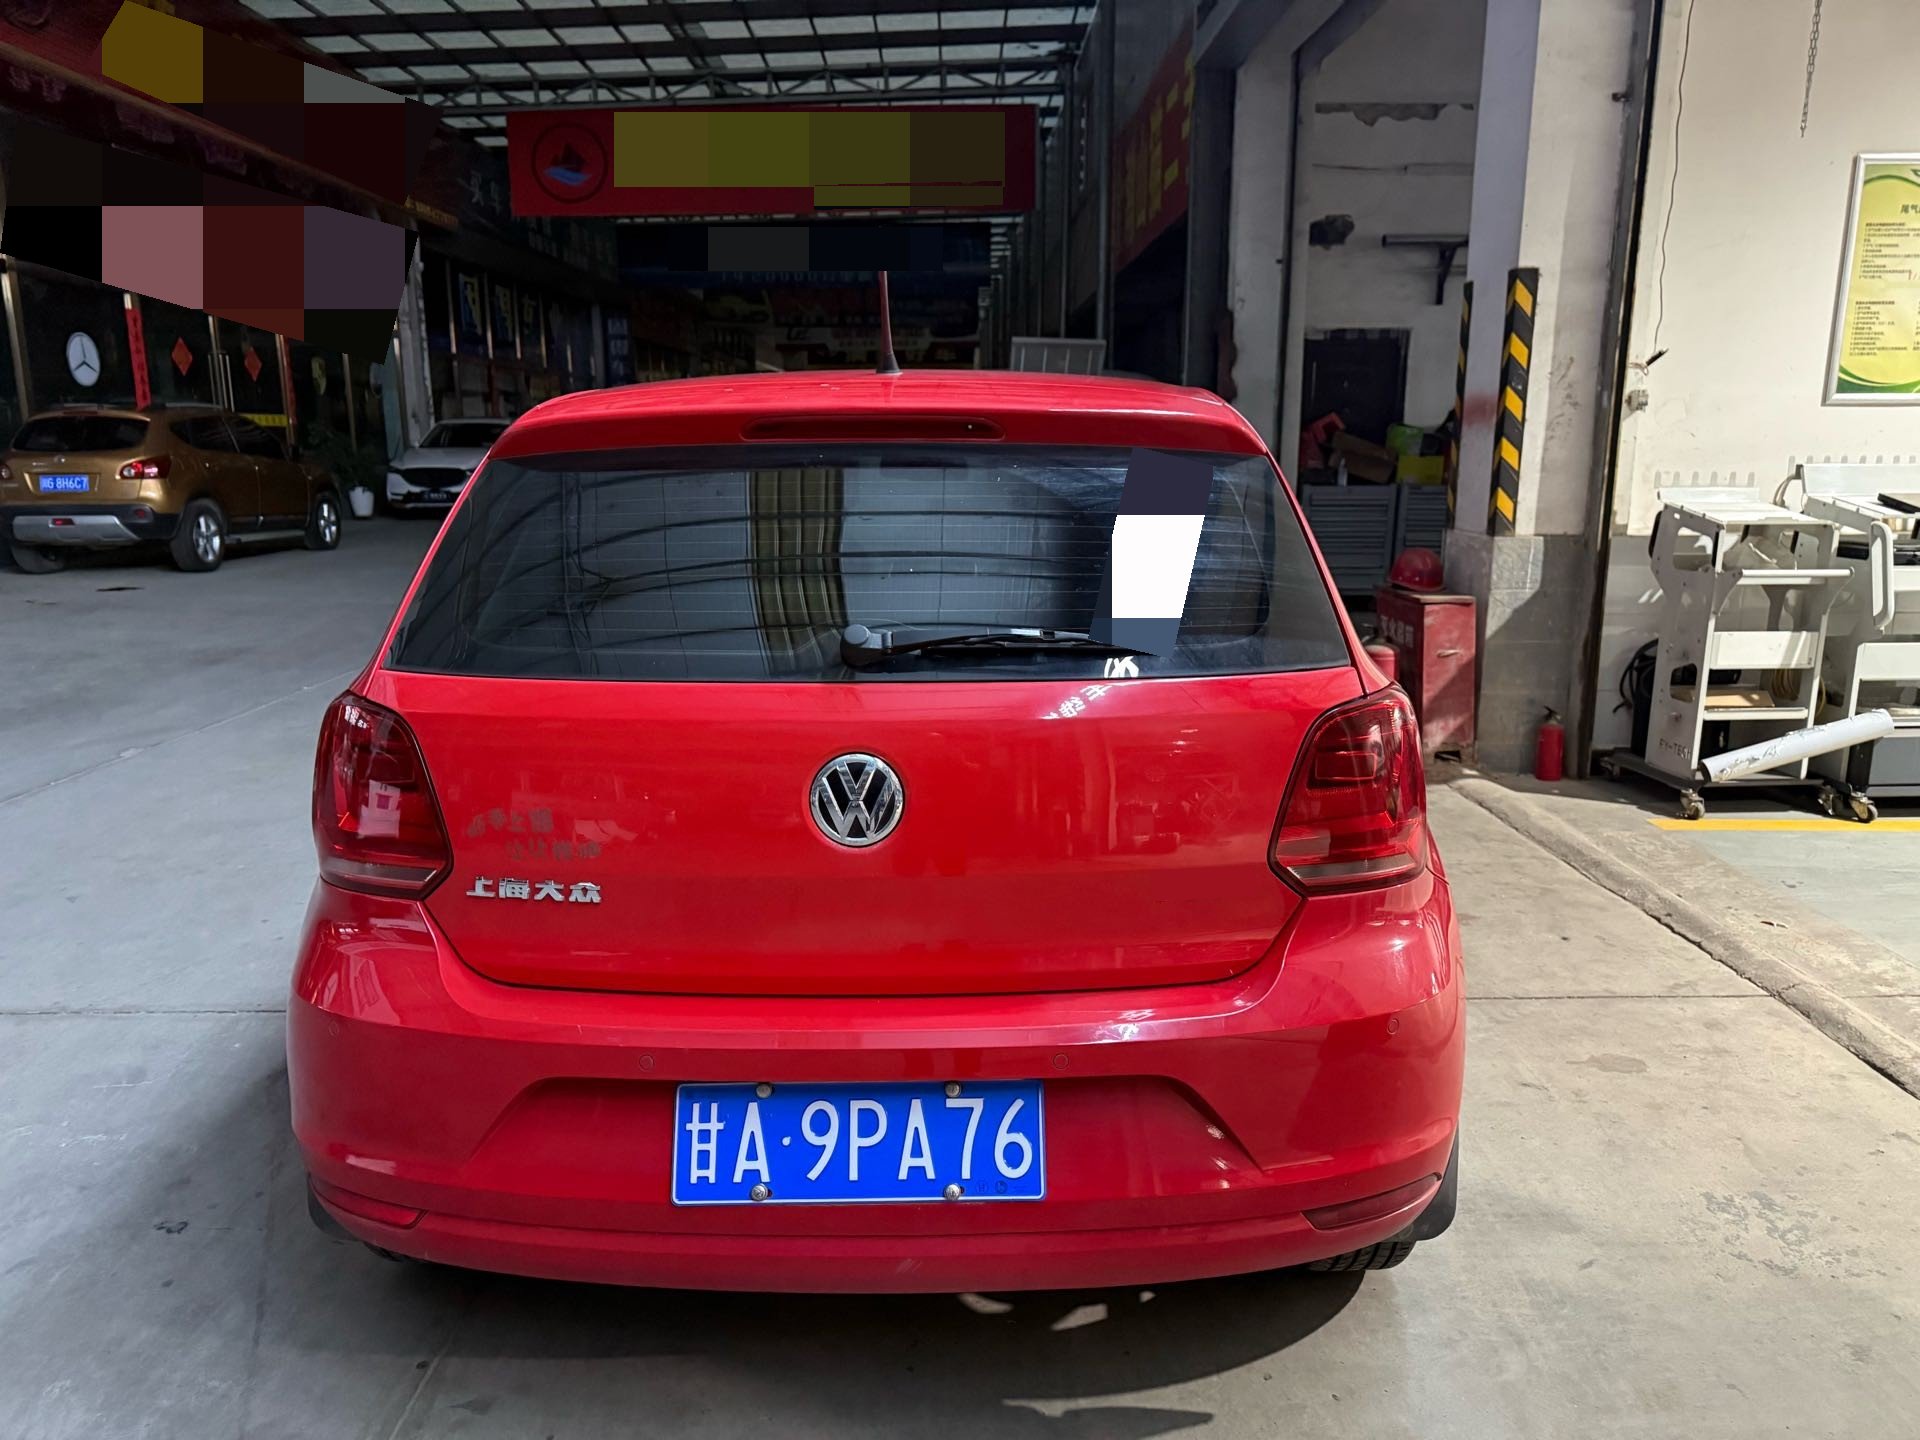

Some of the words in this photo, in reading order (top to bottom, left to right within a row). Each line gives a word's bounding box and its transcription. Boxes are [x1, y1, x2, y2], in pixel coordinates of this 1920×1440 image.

[465, 876, 603, 905] 上海大众
[684, 1097, 1035, 1185] 甘A·9PA76
